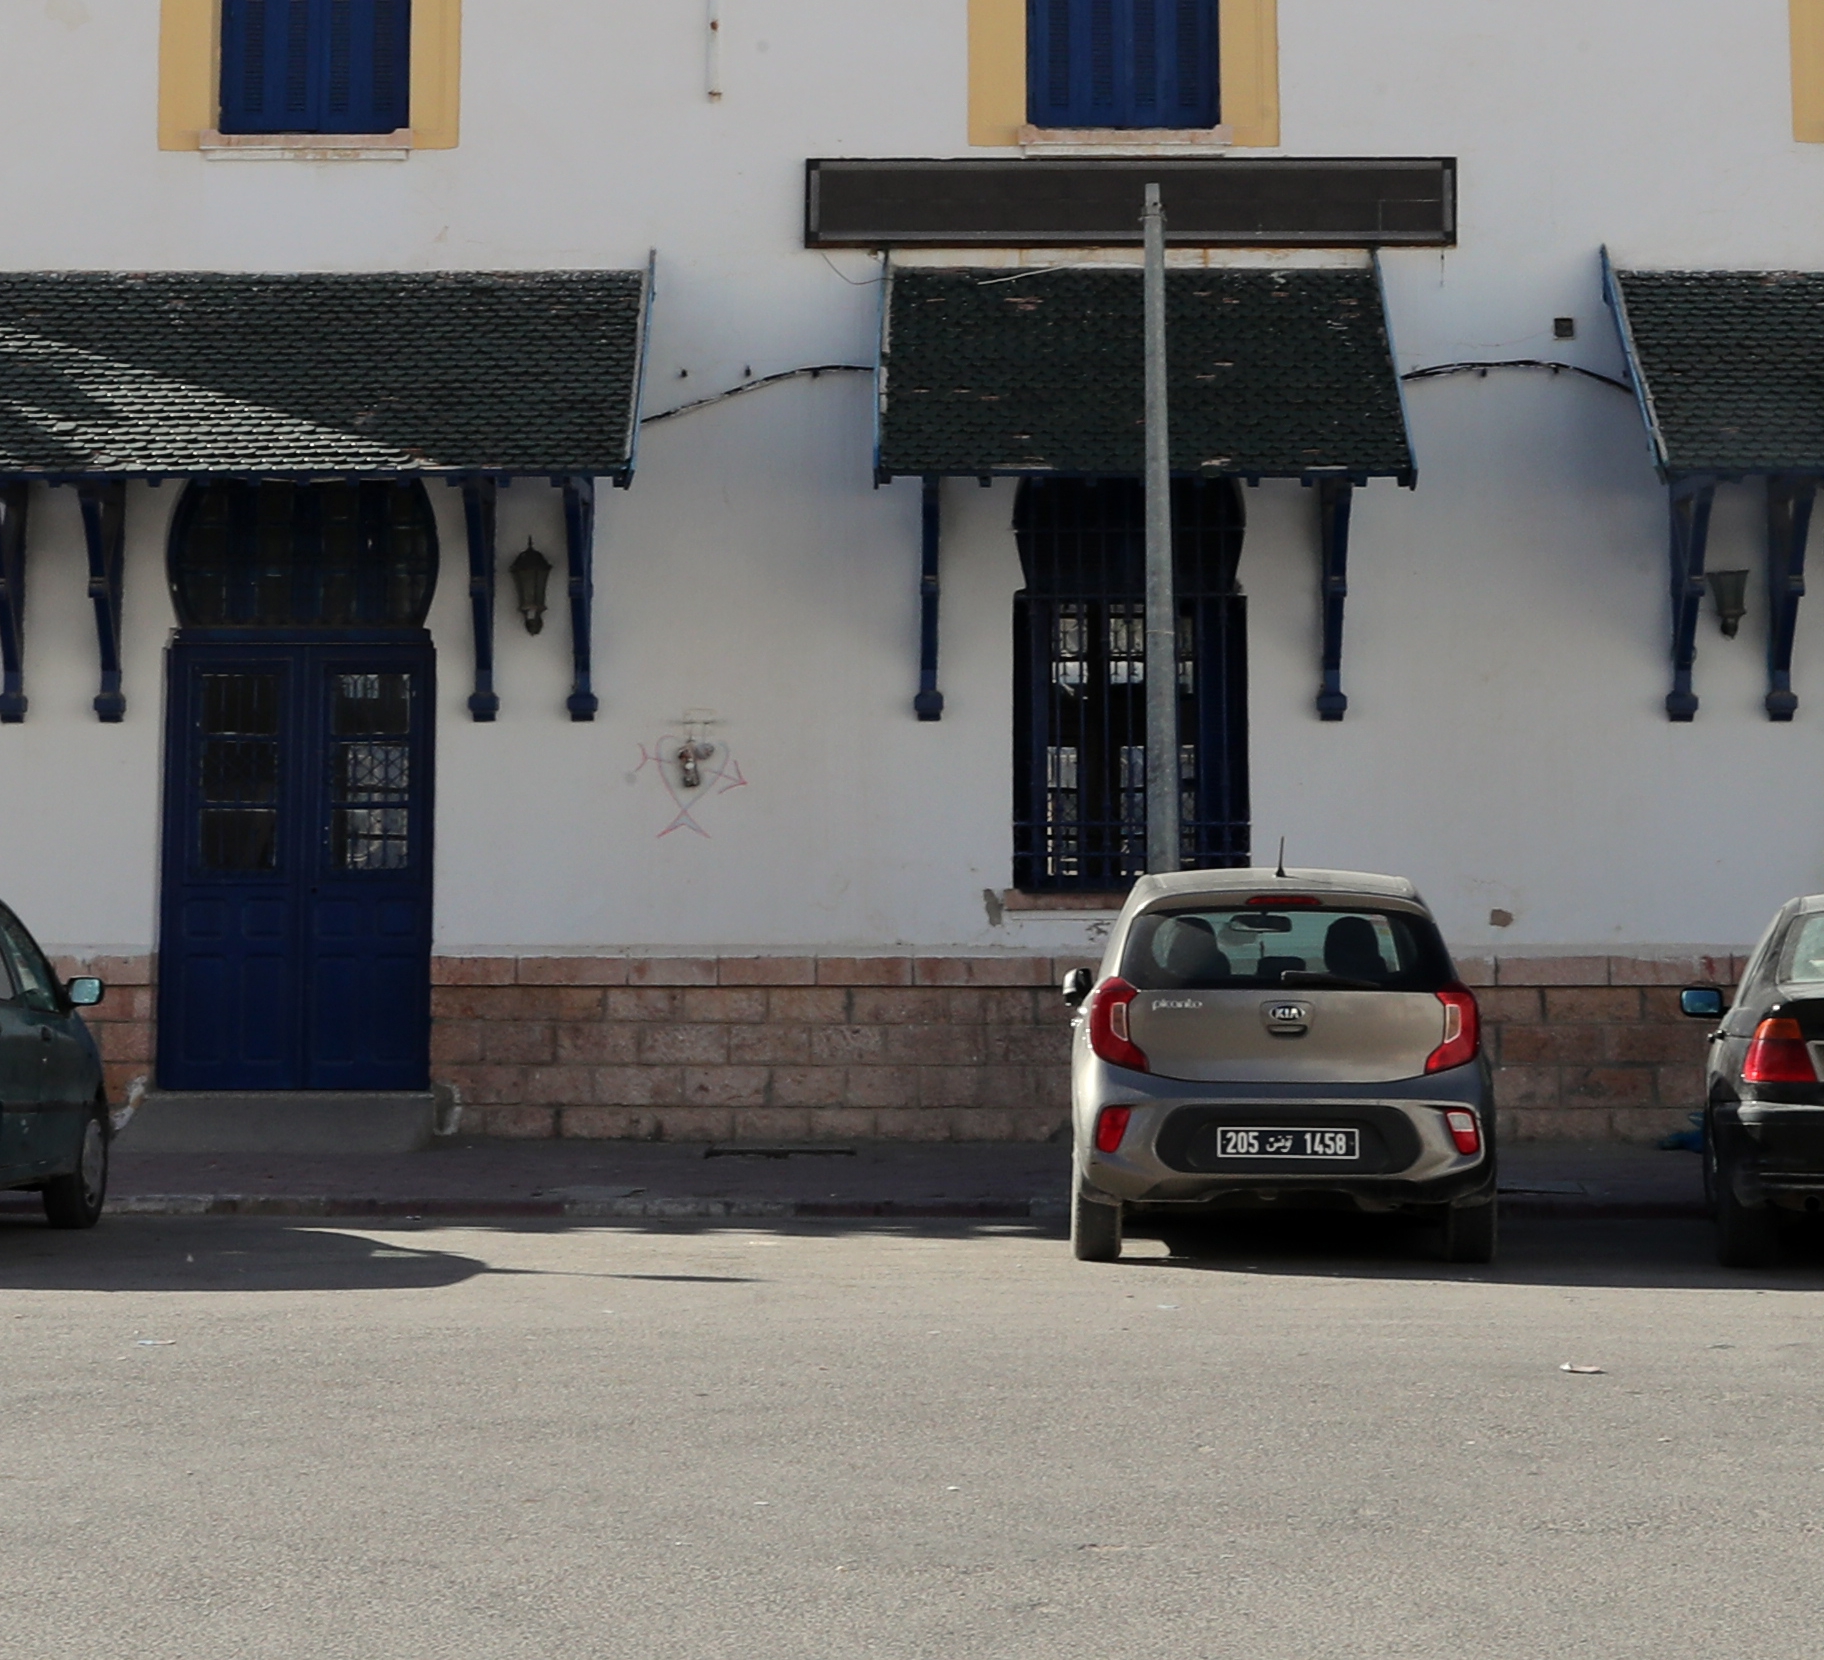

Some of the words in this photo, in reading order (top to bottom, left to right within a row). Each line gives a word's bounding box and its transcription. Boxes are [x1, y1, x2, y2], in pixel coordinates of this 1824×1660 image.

[1225, 1131, 1260, 1154] 205
[1265, 1134, 1294, 1153] تونس
[1304, 1132, 1347, 1155] 1458
